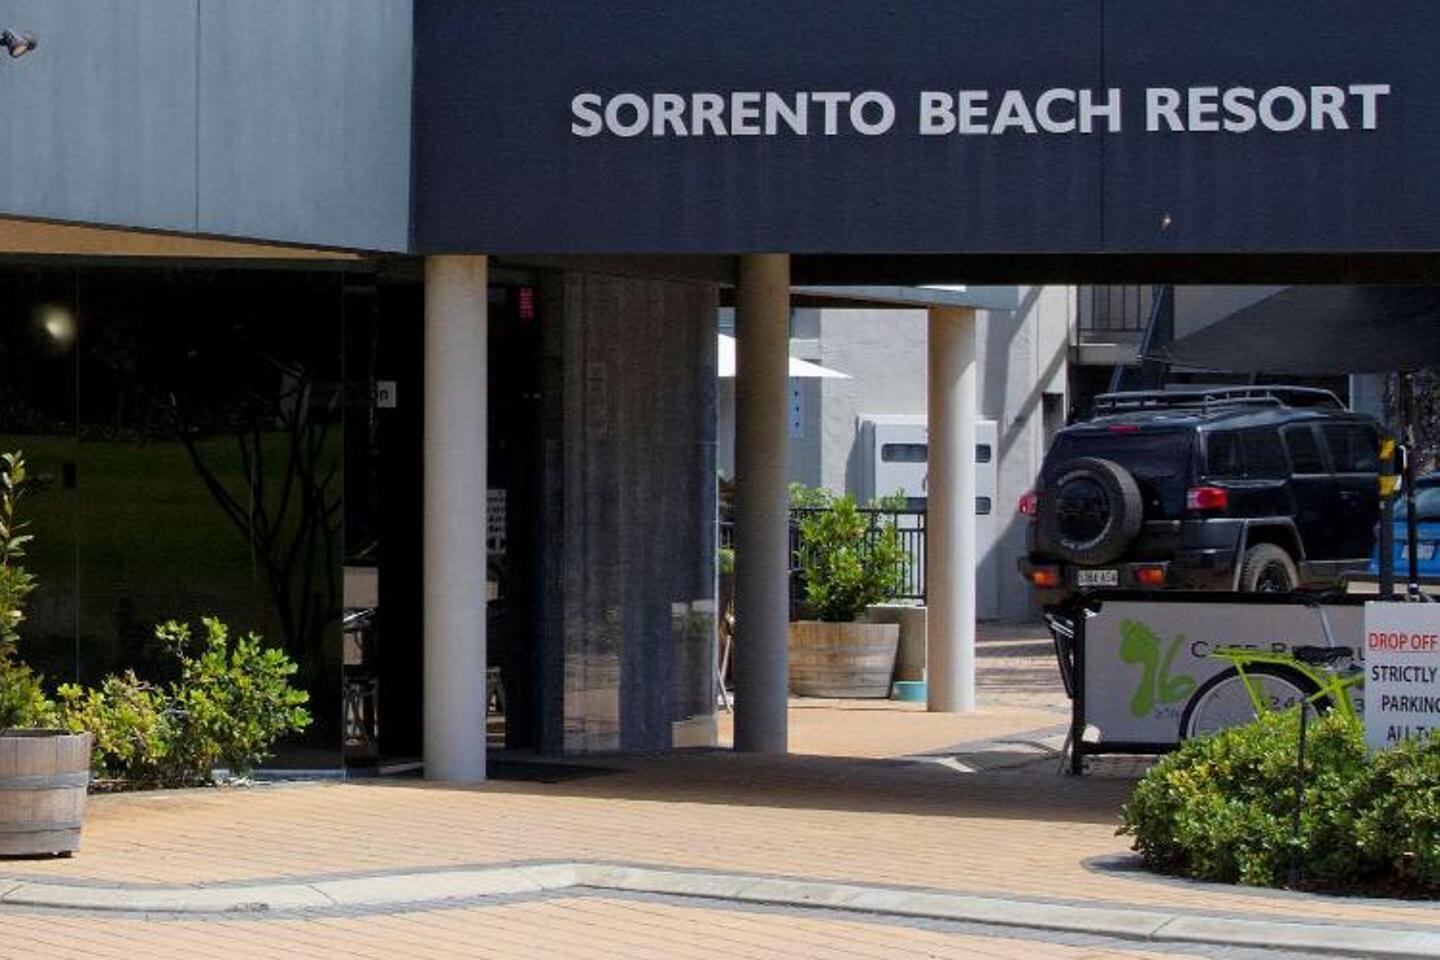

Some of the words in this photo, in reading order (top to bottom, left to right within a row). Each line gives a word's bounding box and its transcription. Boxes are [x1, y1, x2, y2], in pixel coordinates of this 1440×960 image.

[572, 91, 895, 136] SORRENTO
[920, 88, 1121, 134] BEACH
[1146, 84, 1390, 132] RESORT
[1369, 633, 1408, 650] DROP
[1411, 635, 1438, 652] OFF
[1371, 665, 1438, 683] STRICTLY
